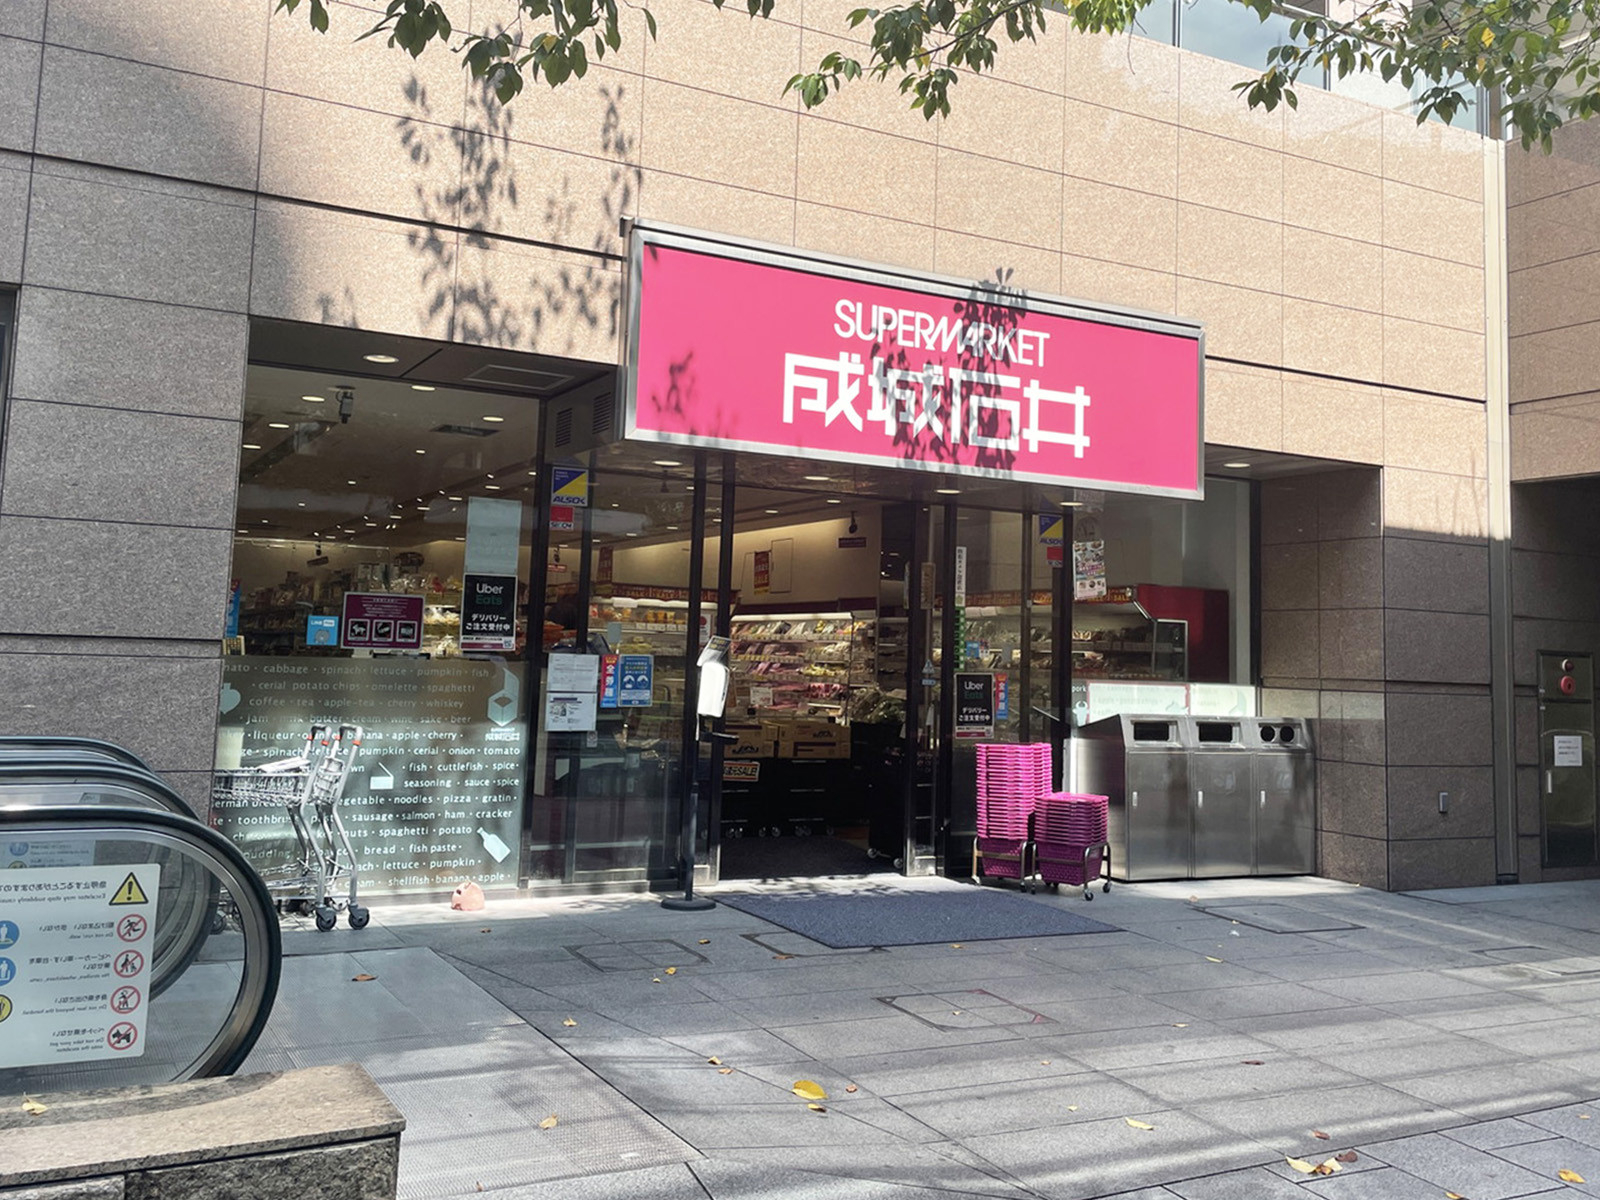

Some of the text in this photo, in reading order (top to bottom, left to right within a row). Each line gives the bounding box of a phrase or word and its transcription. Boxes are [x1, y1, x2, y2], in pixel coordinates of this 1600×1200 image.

[834, 299, 1050, 367] SUPERMARKET
[782, 351, 1091, 459] 成城石井
[553, 496, 585, 504] ALSOK
[476, 582, 504, 594] Uber
[475, 595, 503, 605] Eats
[471, 613, 507, 622] デリバリー
[465, 622, 511, 632] ご注文受付中
[263, 664, 309, 675] cabbage
[321, 664, 361, 675] spinach
[370, 666, 407, 676] lettuce
[416, 666, 463, 677] pumpkin
[471, 667, 489, 677] fish
[258, 681, 475, 693] cerial potato chips omelette spaghetti
[963, 681, 984, 690] Uber
[1071, 685, 1087, 694] pork
[249, 697, 286, 706] coffee
[296, 698, 314, 707] tea
[323, 698, 351, 708] apple
[387, 699, 417, 710] cherry
[425, 699, 464, 710] whiskey
[245, 714, 269, 725] jam
[310, 714, 343, 724] butter
[352, 715, 381, 724] cream
[391, 715, 413, 724] wine
[420, 714, 442, 724] sake
[450, 715, 472, 724] beer
[253, 730, 295, 743] liqueur
[391, 731, 420, 742] apple
[427, 731, 457, 742] cherry
[359, 746, 404, 757] pumpkin
[413, 746, 439, 755] cerial
[448, 747, 475, 756] onion
[483, 746, 521, 756] tomato
[409, 761, 515, 772] fish cuttlefish spice
[404, 777, 520, 789] seasoning sauce spice
[393, 794, 433, 804] noodles
[442, 794, 471, 806] pizza
[481, 793, 511, 804] gratin
[352, 811, 394, 822] sausage
[401, 810, 435, 820] salmon
[444, 809, 465, 819] ham
[475, 808, 513, 819] cracker
[378, 826, 429, 839] spaghetti
[438, 825, 473, 837] potato
[364, 844, 396, 856] bread
[409, 843, 428, 854] fish
[430, 844, 457, 855] paste
[383, 860, 420, 871] lettuce
[429, 857, 475, 870] pumpkin
[387, 874, 430, 887] shellfish
[478, 872, 505, 884] apple
